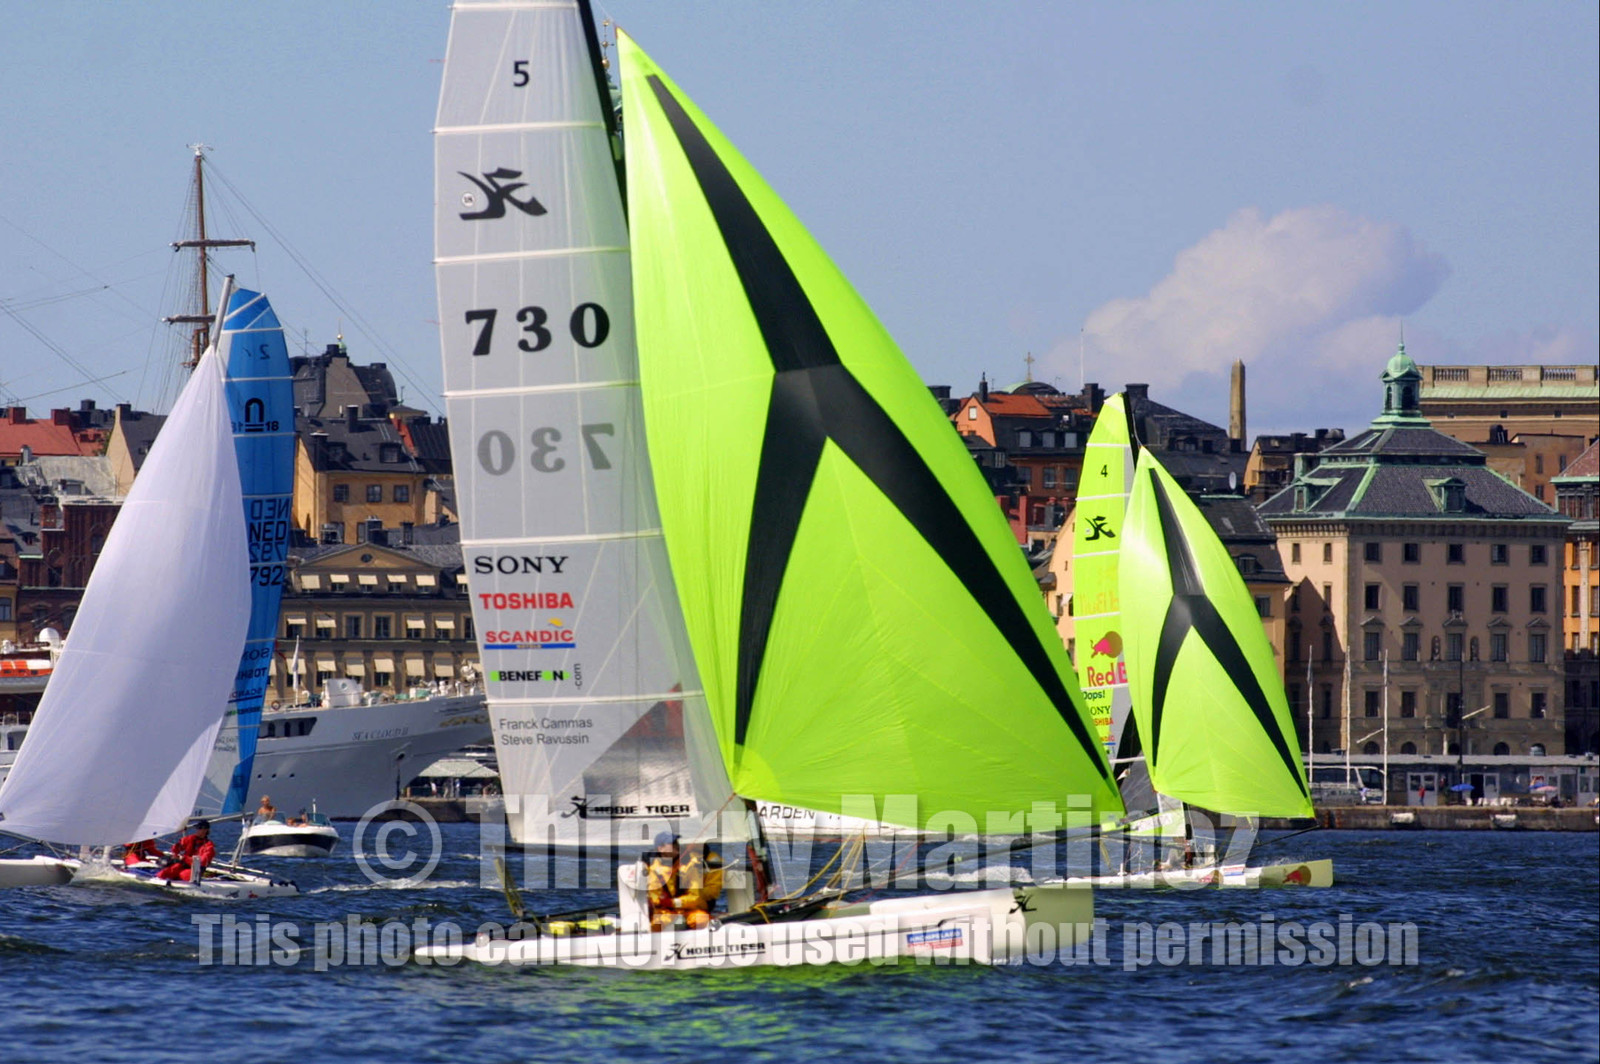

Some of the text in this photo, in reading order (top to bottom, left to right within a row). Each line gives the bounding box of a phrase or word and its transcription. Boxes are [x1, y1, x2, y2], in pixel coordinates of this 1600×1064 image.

[512, 60, 530, 87] 5
[464, 302, 610, 356] 730
[265, 420, 279, 432] 18
[1100, 464, 1109, 478] 4
[249, 520, 287, 542] NED
[474, 555, 569, 575] SONY
[249, 565, 283, 587] 792
[478, 591, 575, 610] TOSHIBA
[485, 629, 575, 643] SCANDIC
[1087, 662, 1116, 687] Red
[1090, 705, 1111, 716] ONY
[499, 717, 593, 730] Franck Cammas
[1093, 717, 1114, 727] SHIBA
[501, 732, 590, 746] Steve Ravussin
[593, 804, 690, 815] HOBIE TIGER
[759, 804, 816, 820] ARDEN
[686, 942, 766, 956] HOBIE TIGER
